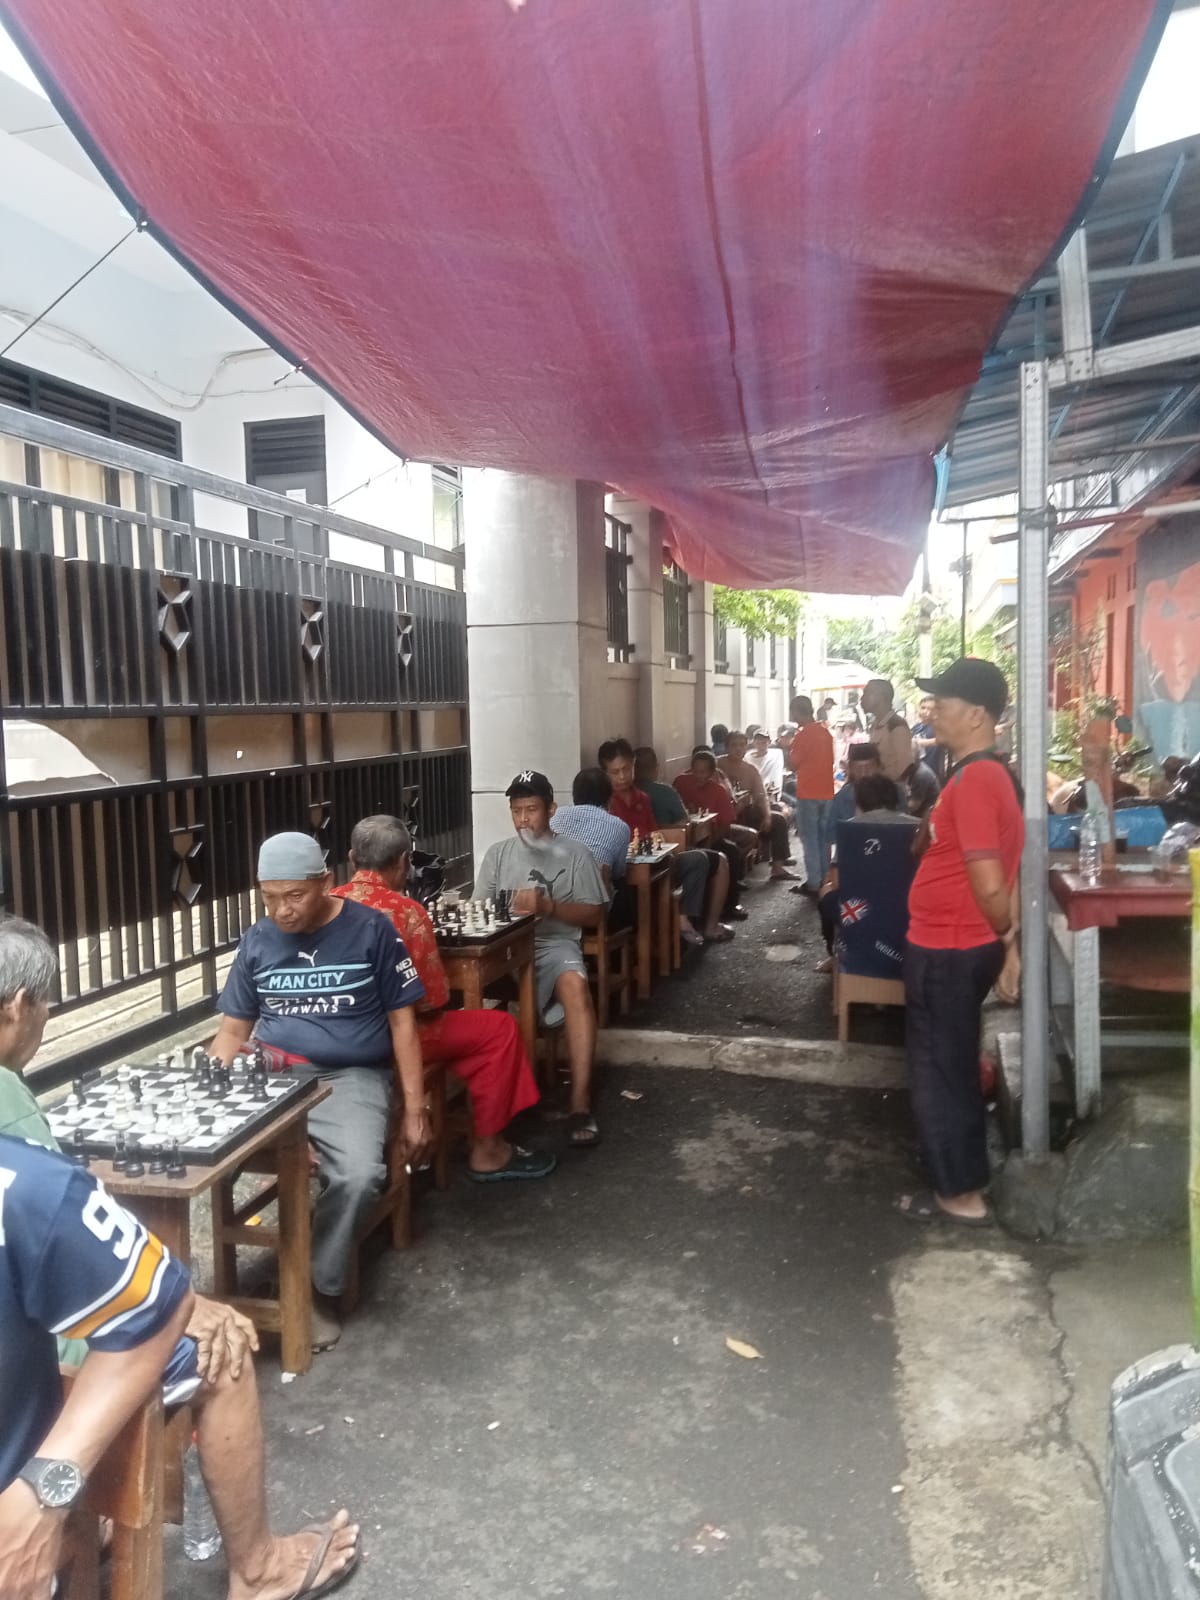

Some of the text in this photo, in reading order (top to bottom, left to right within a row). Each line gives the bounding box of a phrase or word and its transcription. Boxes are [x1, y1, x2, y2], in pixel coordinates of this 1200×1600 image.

[268, 972, 345, 989] MAN CITY
[82, 1177, 136, 1260] 9
